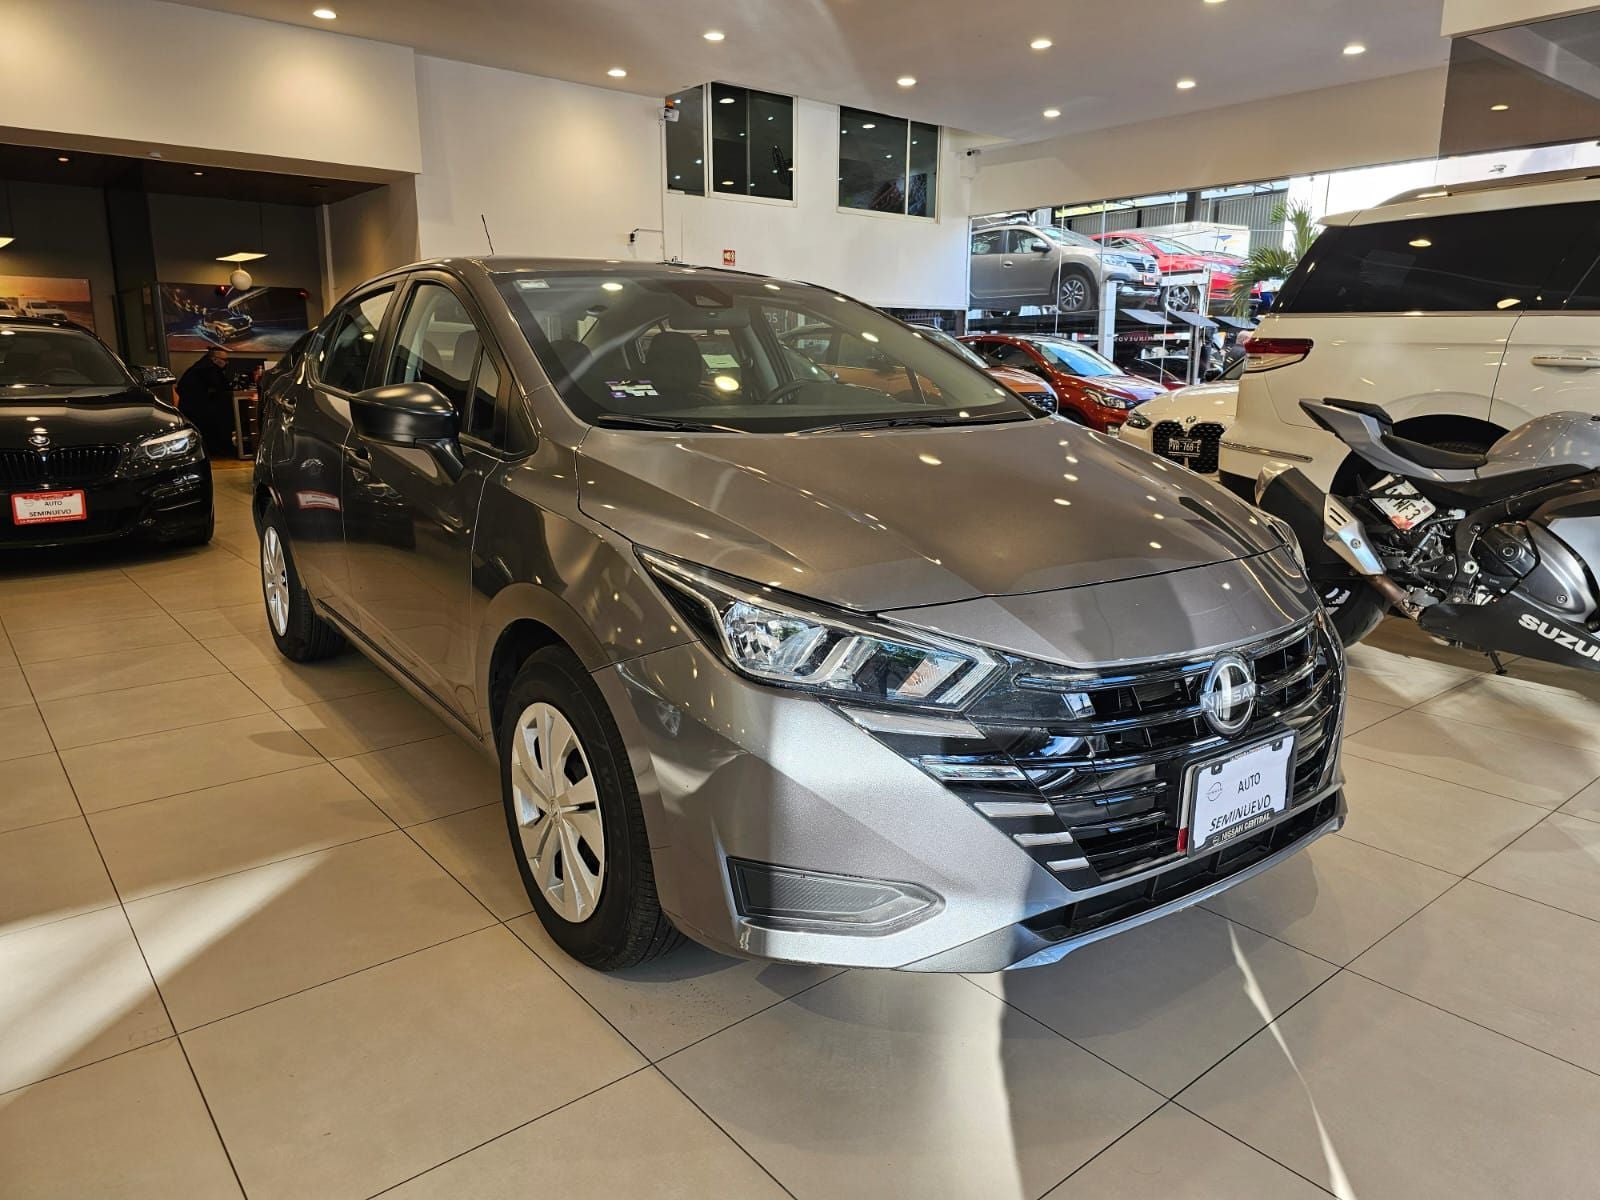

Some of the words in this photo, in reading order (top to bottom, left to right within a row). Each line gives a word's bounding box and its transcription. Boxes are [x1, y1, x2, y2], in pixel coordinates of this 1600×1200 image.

[28, 508, 72, 517] SEMINUEVO
[1237, 772, 1261, 794] AUTO
[1209, 794, 1271, 832] SEMINUEVO
[1221, 823, 1243, 840] NISSAN
[1244, 813, 1271, 830] CENTRAL
